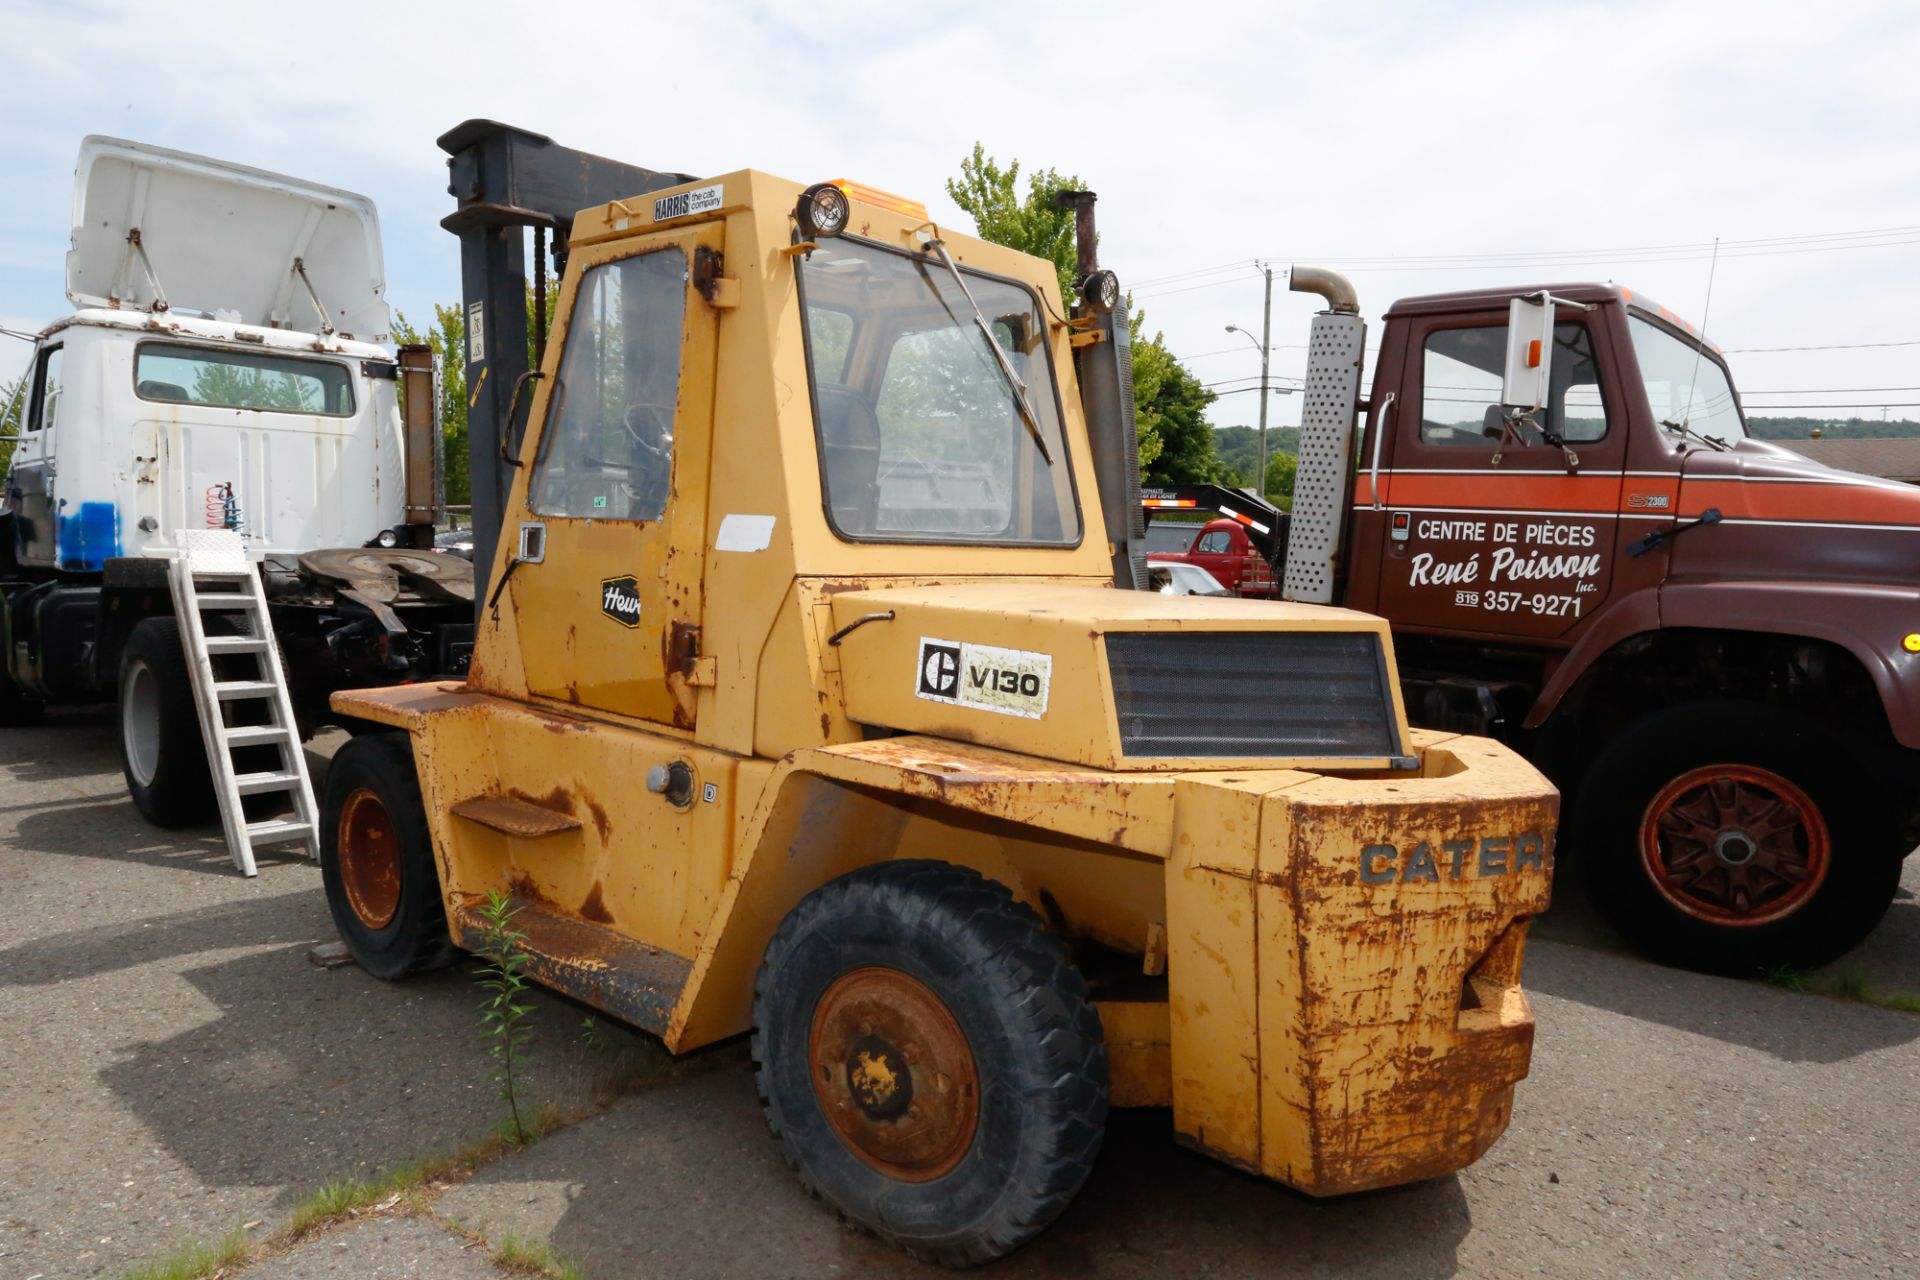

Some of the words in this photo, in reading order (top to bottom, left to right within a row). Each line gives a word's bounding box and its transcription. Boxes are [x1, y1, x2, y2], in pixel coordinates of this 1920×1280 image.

[655, 193, 689, 220] HARRIS
[691, 197, 721, 210] company
[692, 192, 702, 202] the
[702, 189, 715, 199] cab
[1418, 520, 1487, 541] CENTRE
[1493, 523, 1519, 543] DE
[1525, 520, 1595, 547] PIÈCES
[1409, 552, 1480, 587] René
[1489, 547, 1600, 582] Poisson
[1575, 580, 1597, 593] Inc.
[1455, 592, 1479, 605] 819
[1483, 590, 1581, 617] 357-9271
[970, 664, 1040, 697] V130
